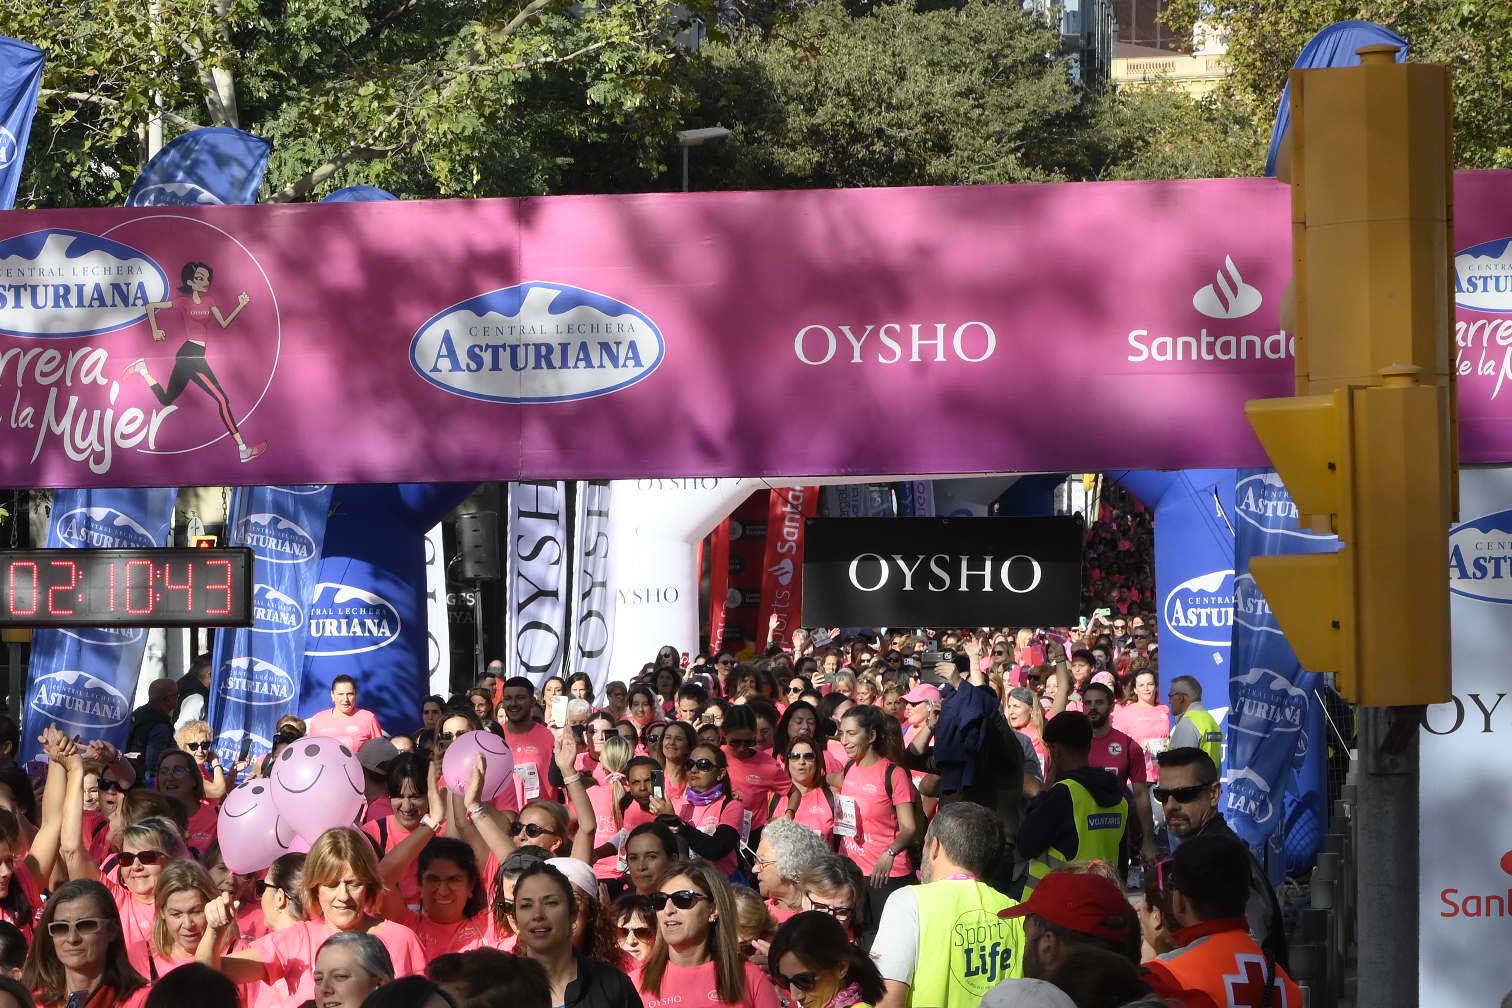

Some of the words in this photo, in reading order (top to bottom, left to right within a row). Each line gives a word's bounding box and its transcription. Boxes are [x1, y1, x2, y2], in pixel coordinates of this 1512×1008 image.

[72, 265, 144, 277] LECHERA
[1468, 262, 1512, 272] CENTRA
[468, 325, 548, 338] CENTRAL
[554, 322, 637, 335] LECHERA
[794, 321, 997, 366] OYSHO
[429, 329, 645, 373] ASTURIANA
[1477, 347, 1496, 376] la
[10, 389, 34, 429] la
[31, 381, 179, 475] Mujer
[1240, 487, 1300, 520] ASTUR
[517, 481, 562, 674] OYSH
[578, 481, 610, 659] OYSH
[848, 553, 1042, 593] OYSHO
[10, 560, 231, 615] 02:10:43
[618, 586, 679, 605] YSHO
[253, 607, 297, 627] RIANA
[311, 607, 334, 616] TRAL
[338, 606, 388, 617] LECHERA
[1171, 598, 1234, 627] ASTU
[310, 617, 392, 638] URIANA
[33, 683, 122, 721] ASTURIANA
[1235, 696, 1301, 726] TURIANA
[954, 919, 1005, 948] Sport
[964, 942, 1012, 983] Life
[648, 995, 682, 1008] OYSHO
